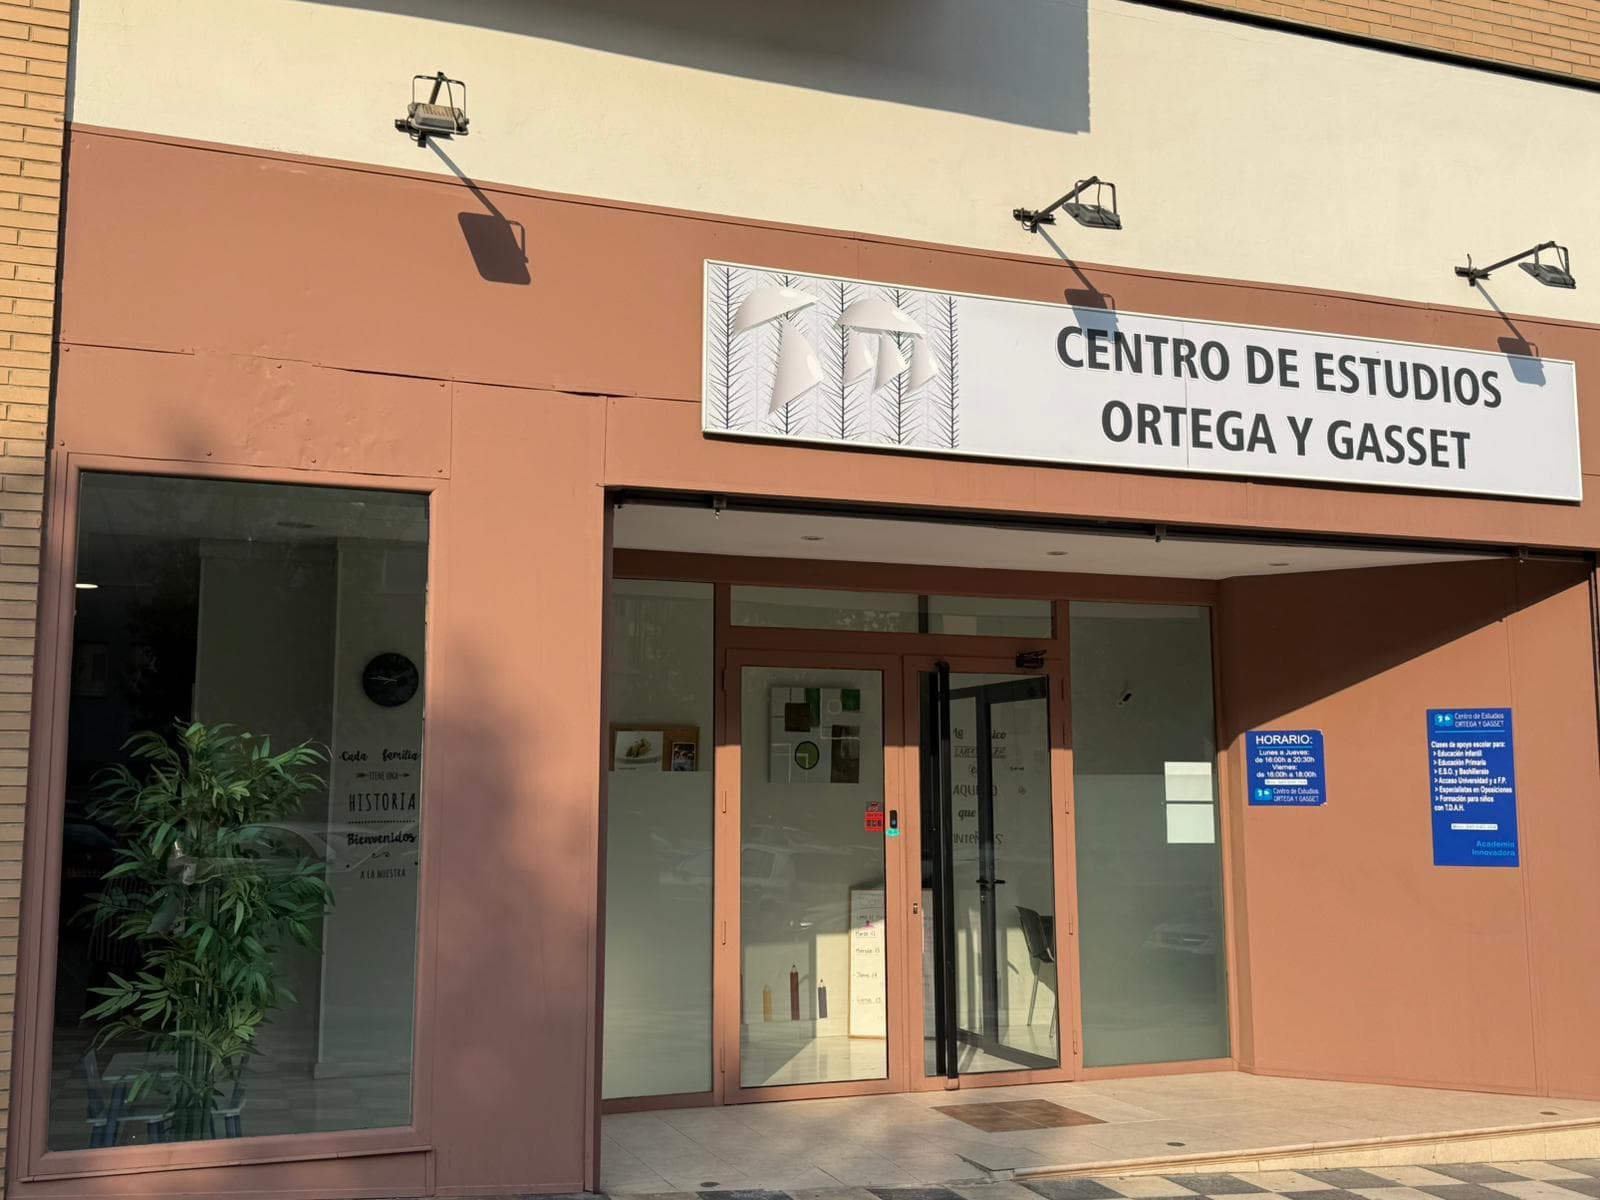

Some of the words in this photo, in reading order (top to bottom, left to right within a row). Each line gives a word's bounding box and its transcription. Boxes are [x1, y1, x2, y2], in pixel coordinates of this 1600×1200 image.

[1057, 326, 1230, 382] CENTRO
[1246, 344, 1300, 389] DE
[1315, 352, 1502, 408] ESTUDIOS
[1101, 399, 1277, 454] ORTEGA
[1287, 416, 1313, 457] Y
[1326, 419, 1471, 470] GASSET
[1256, 735, 1313, 744] HORARIO:
[340, 750, 368, 762] Cada
[382, 749, 420, 762] familia
[349, 792, 416, 812] HISTORIA
[958, 809, 976, 820] que
[346, 830, 416, 846] Bienvenidos
[367, 870, 375, 879] LA
